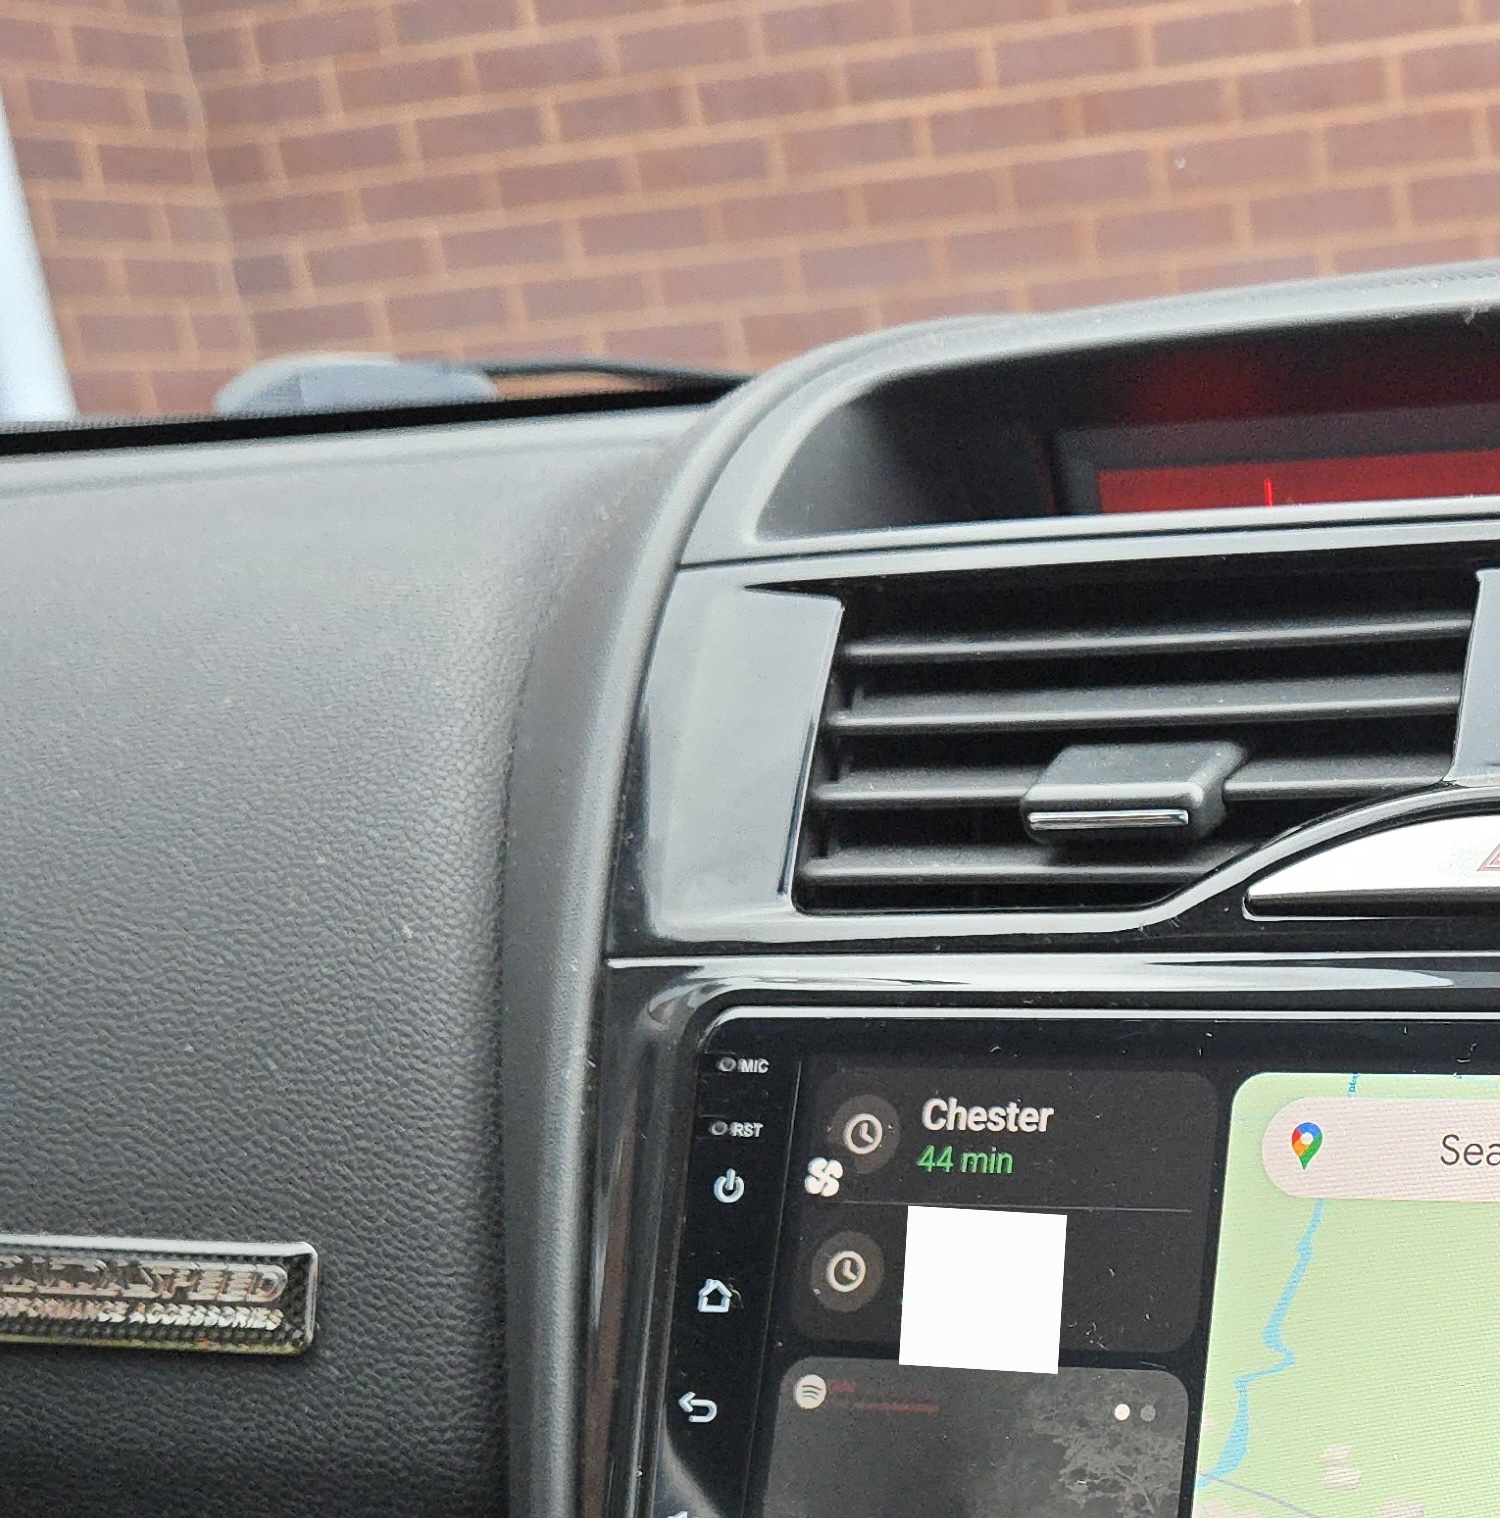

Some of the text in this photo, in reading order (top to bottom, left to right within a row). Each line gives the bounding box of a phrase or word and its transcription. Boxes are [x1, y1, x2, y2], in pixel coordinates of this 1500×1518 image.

[738, 1058, 770, 1074] MIC
[921, 1096, 1055, 1133] Chester
[729, 1121, 764, 1138] RST
[917, 1144, 1014, 1174] 44 min
